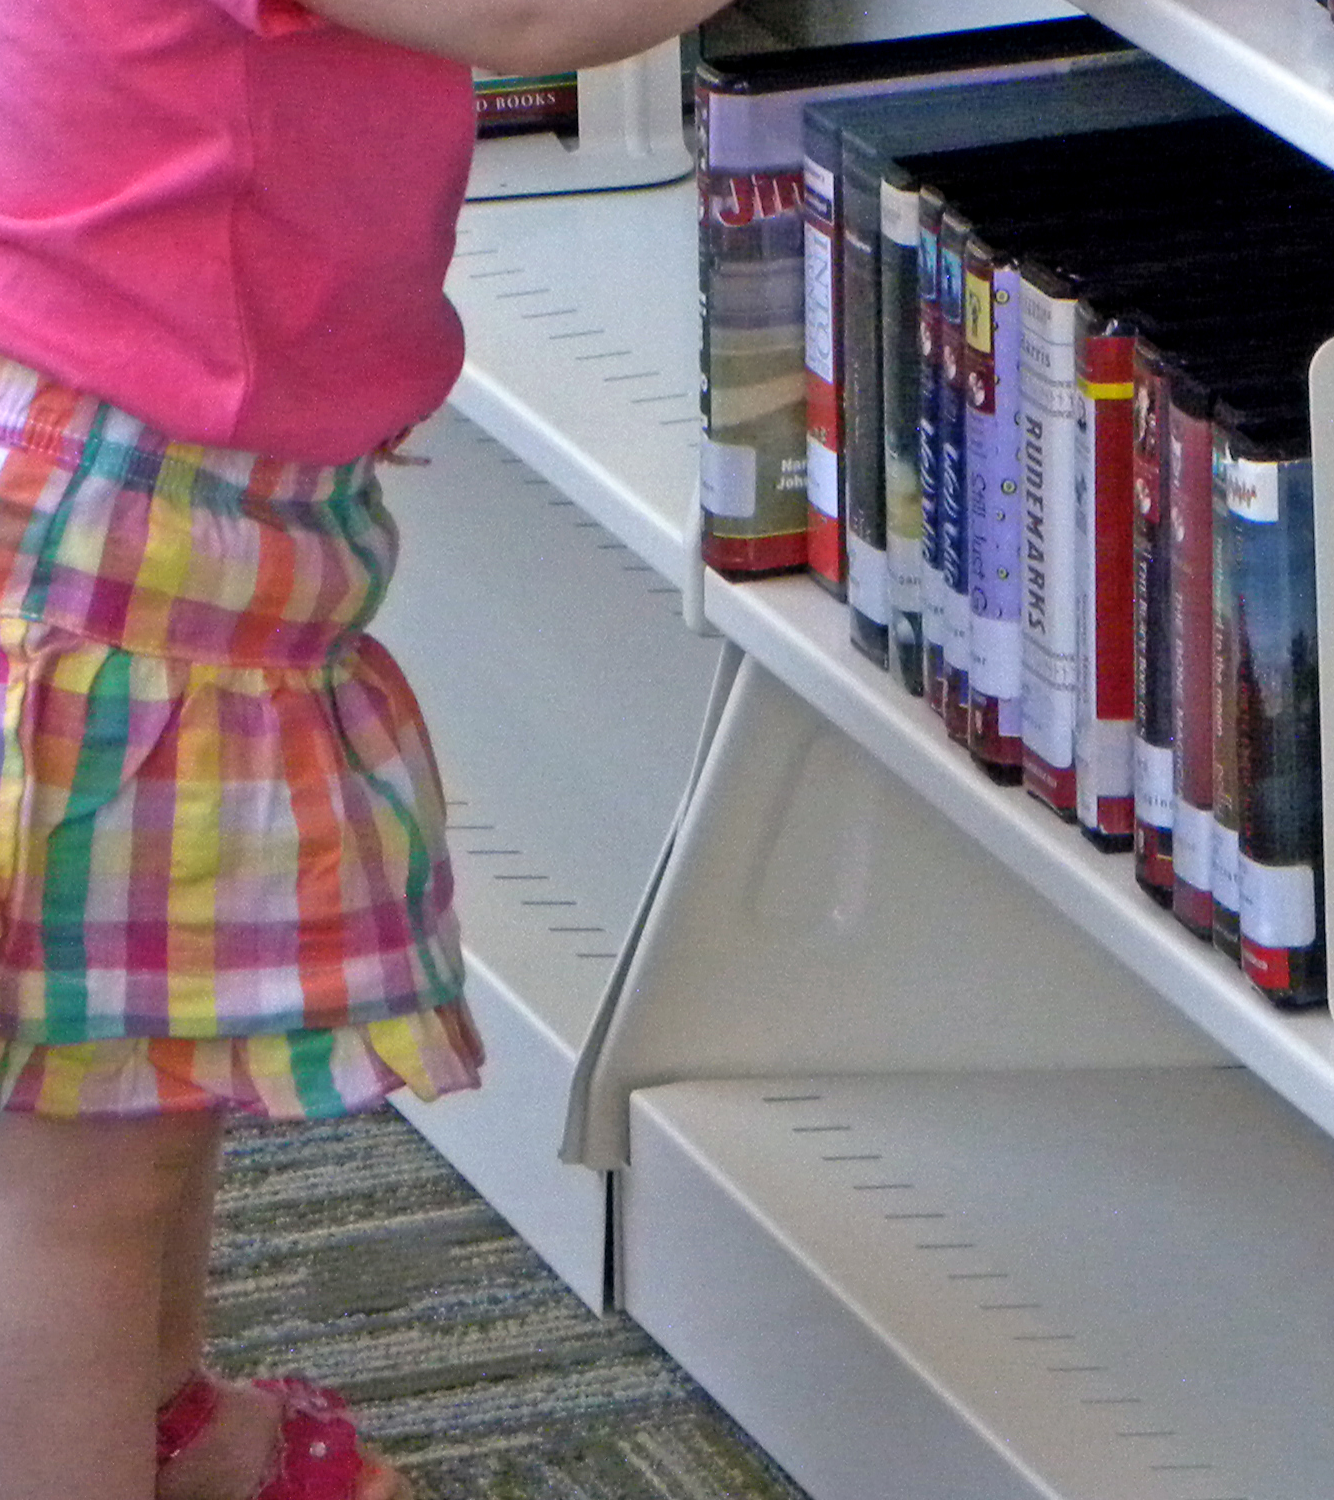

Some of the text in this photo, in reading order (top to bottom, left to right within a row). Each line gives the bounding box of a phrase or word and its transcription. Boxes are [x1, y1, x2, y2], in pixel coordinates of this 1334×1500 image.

[495, 91, 557, 110] BOOKS
[813, 236, 830, 361] INTO
[971, 533, 987, 580] Just
[1175, 638, 1185, 701] BONE
